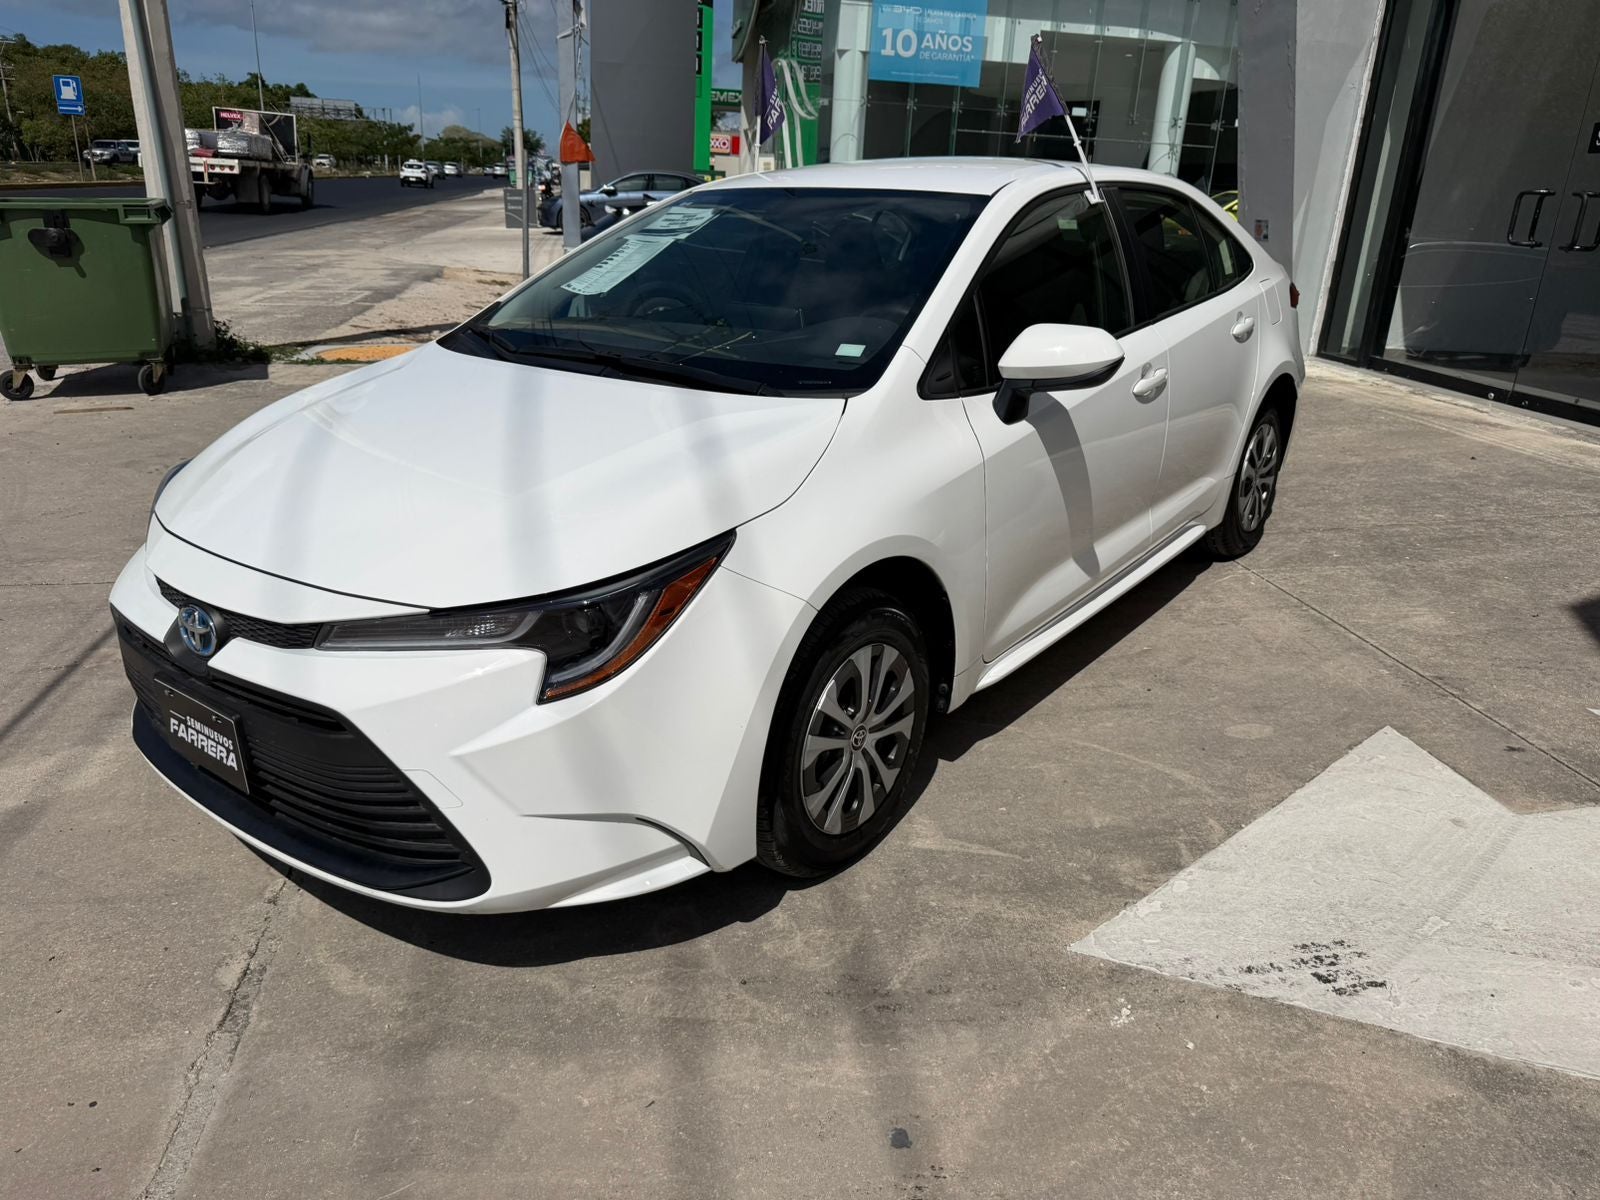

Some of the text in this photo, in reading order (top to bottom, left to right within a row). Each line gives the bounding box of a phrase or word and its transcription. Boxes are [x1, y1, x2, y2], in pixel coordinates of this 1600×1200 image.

[881, 28, 918, 58] 10
[921, 30, 973, 52] AÑOS
[920, 51, 930, 60] DE
[711, 91, 742, 102] EMEX
[169, 717, 238, 771] FARRERA
[187, 716, 233, 750] SEMINUEVOS
